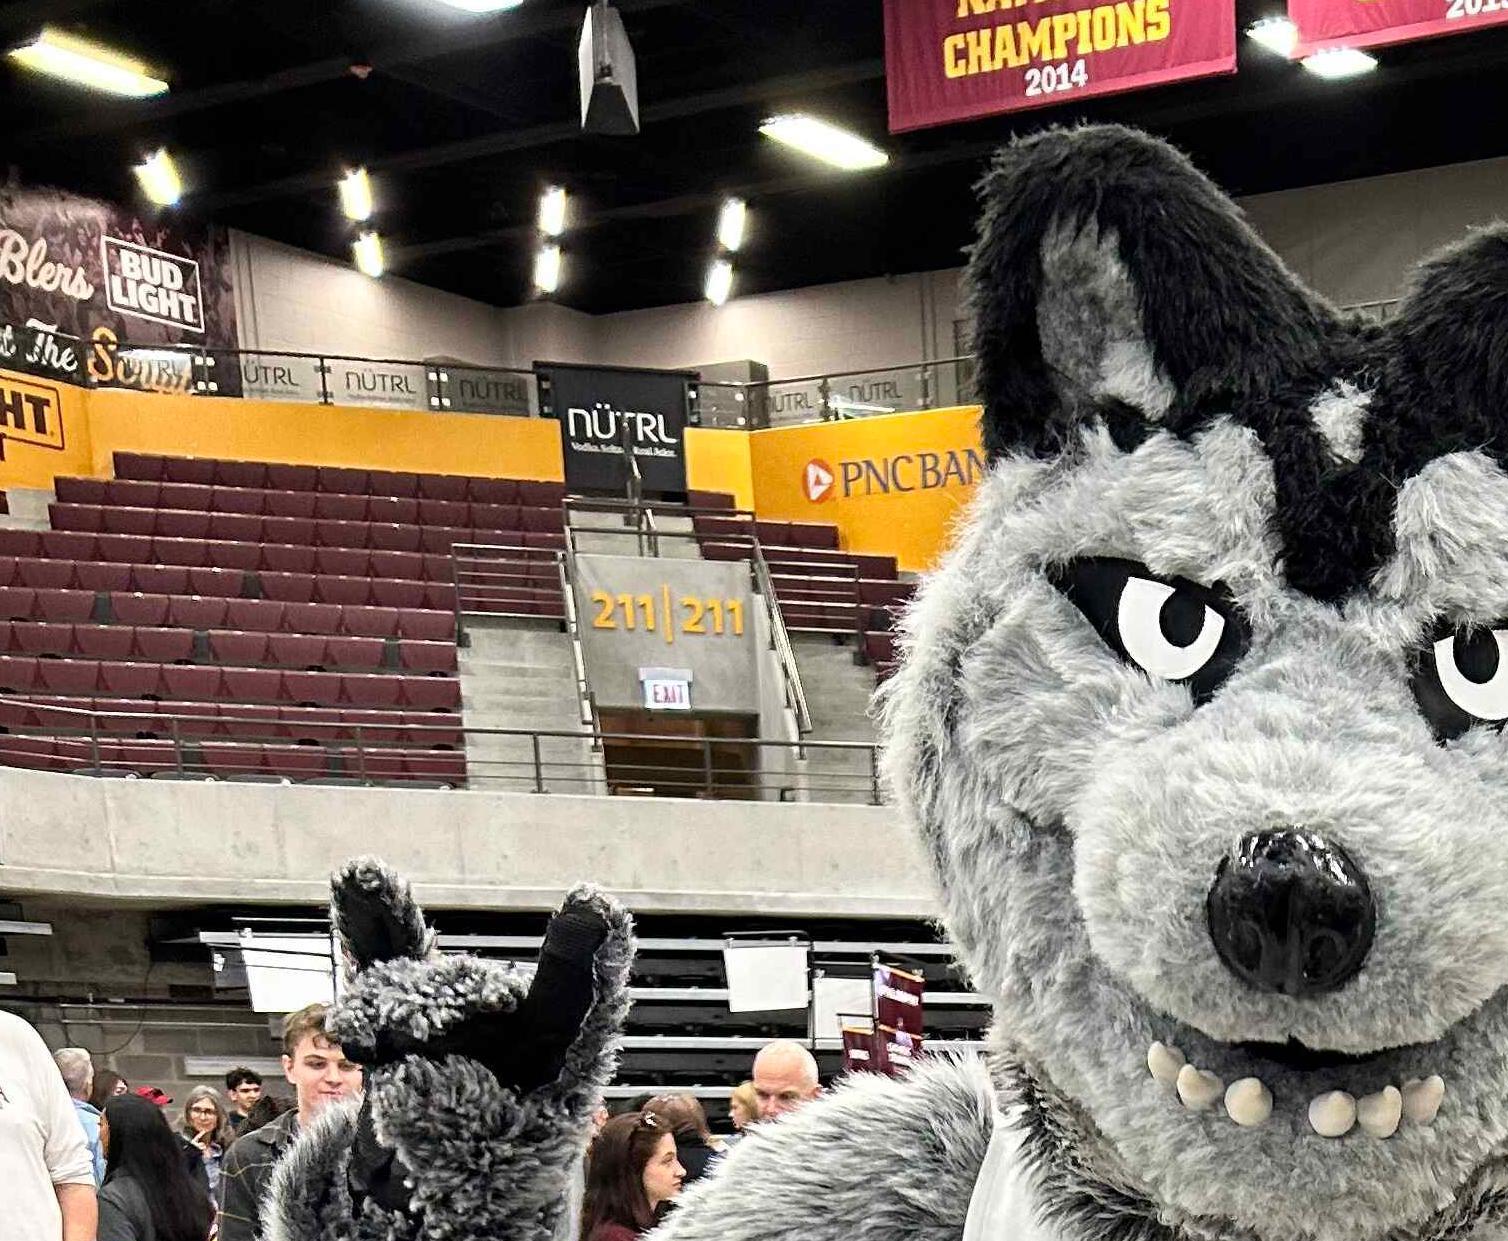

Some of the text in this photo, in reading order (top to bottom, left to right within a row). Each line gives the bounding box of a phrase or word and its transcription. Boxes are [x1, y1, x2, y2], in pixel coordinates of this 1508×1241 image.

[943, 0, 1171, 79] CHAMPIONS
[1025, 59, 1088, 97] 2014
[119, 248, 183, 291] BUD
[111, 274, 198, 324] LIGHT
[243, 361, 299, 387] ÜTRL
[838, 448, 986, 497] PNC BAN
[653, 684, 684, 704] EXIT
